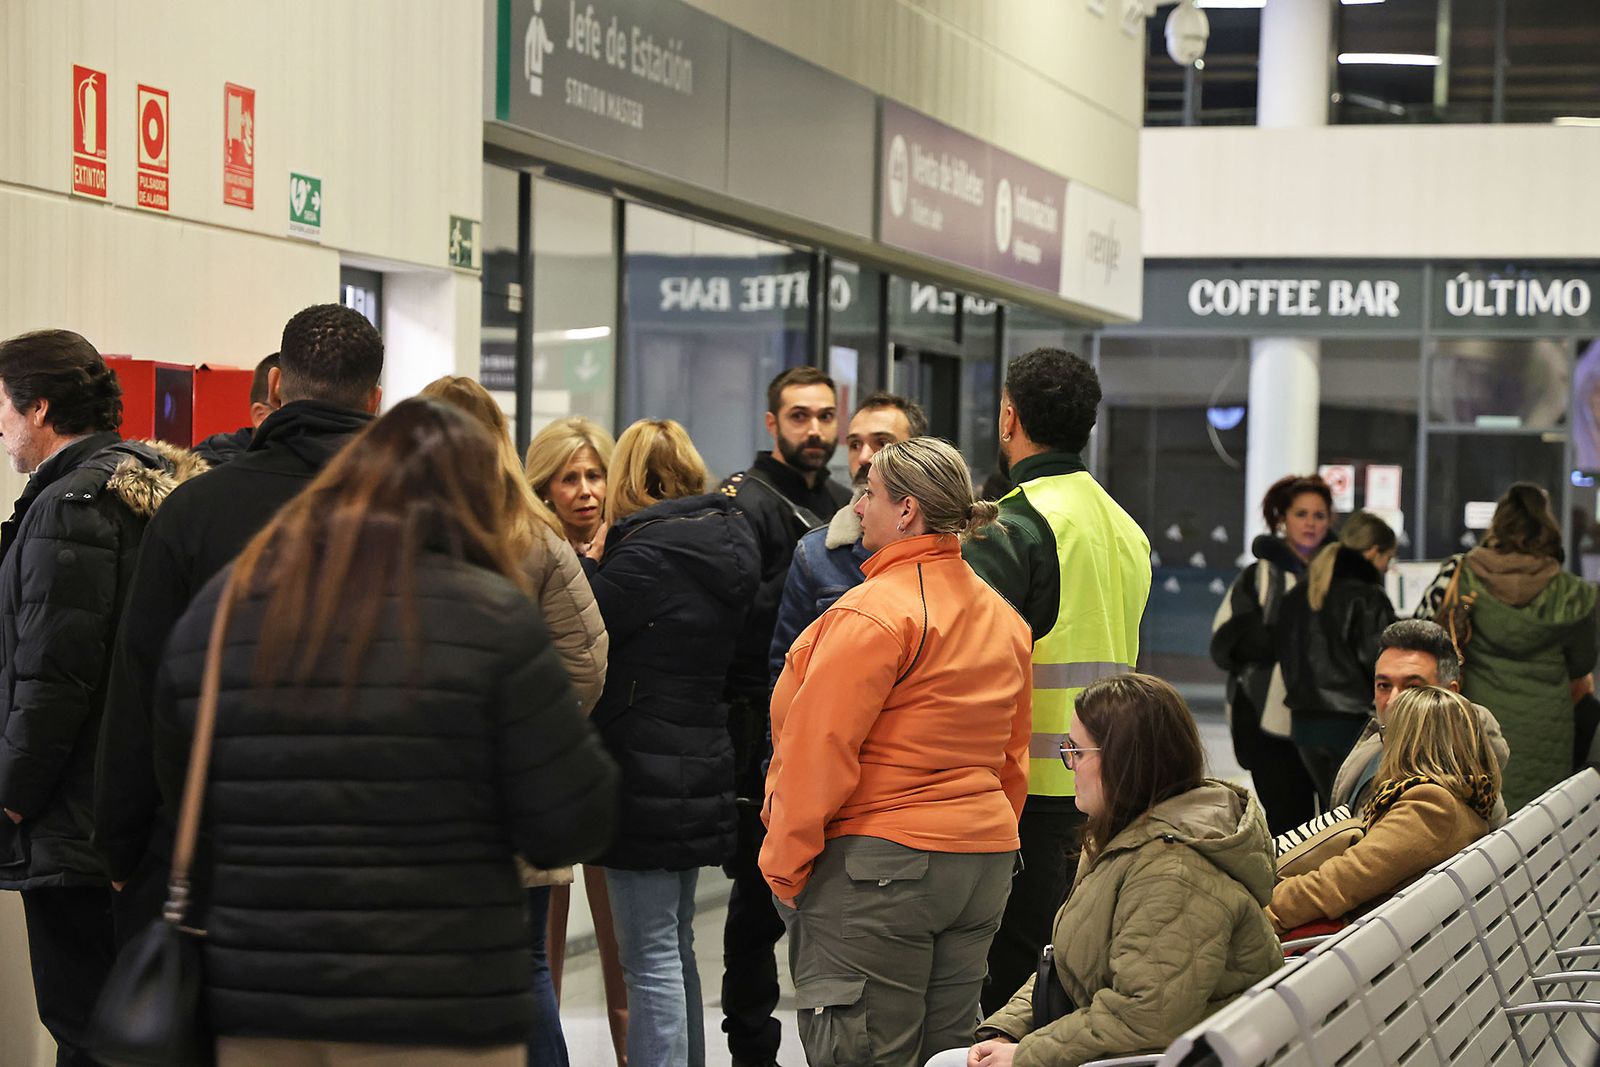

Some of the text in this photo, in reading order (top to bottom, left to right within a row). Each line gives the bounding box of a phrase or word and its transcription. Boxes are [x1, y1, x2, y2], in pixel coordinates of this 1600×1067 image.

[566, 0, 693, 95] Jefe de Estación
[565, 77, 643, 129] STATION MASTER
[74, 163, 106, 190] EXTINTOR
[139, 175, 167, 192] PULSADOR
[138, 190, 147, 203] DE
[1188, 279, 1400, 317] COFFEE BAR
[1445, 271, 1591, 317] ÚLTIMO
